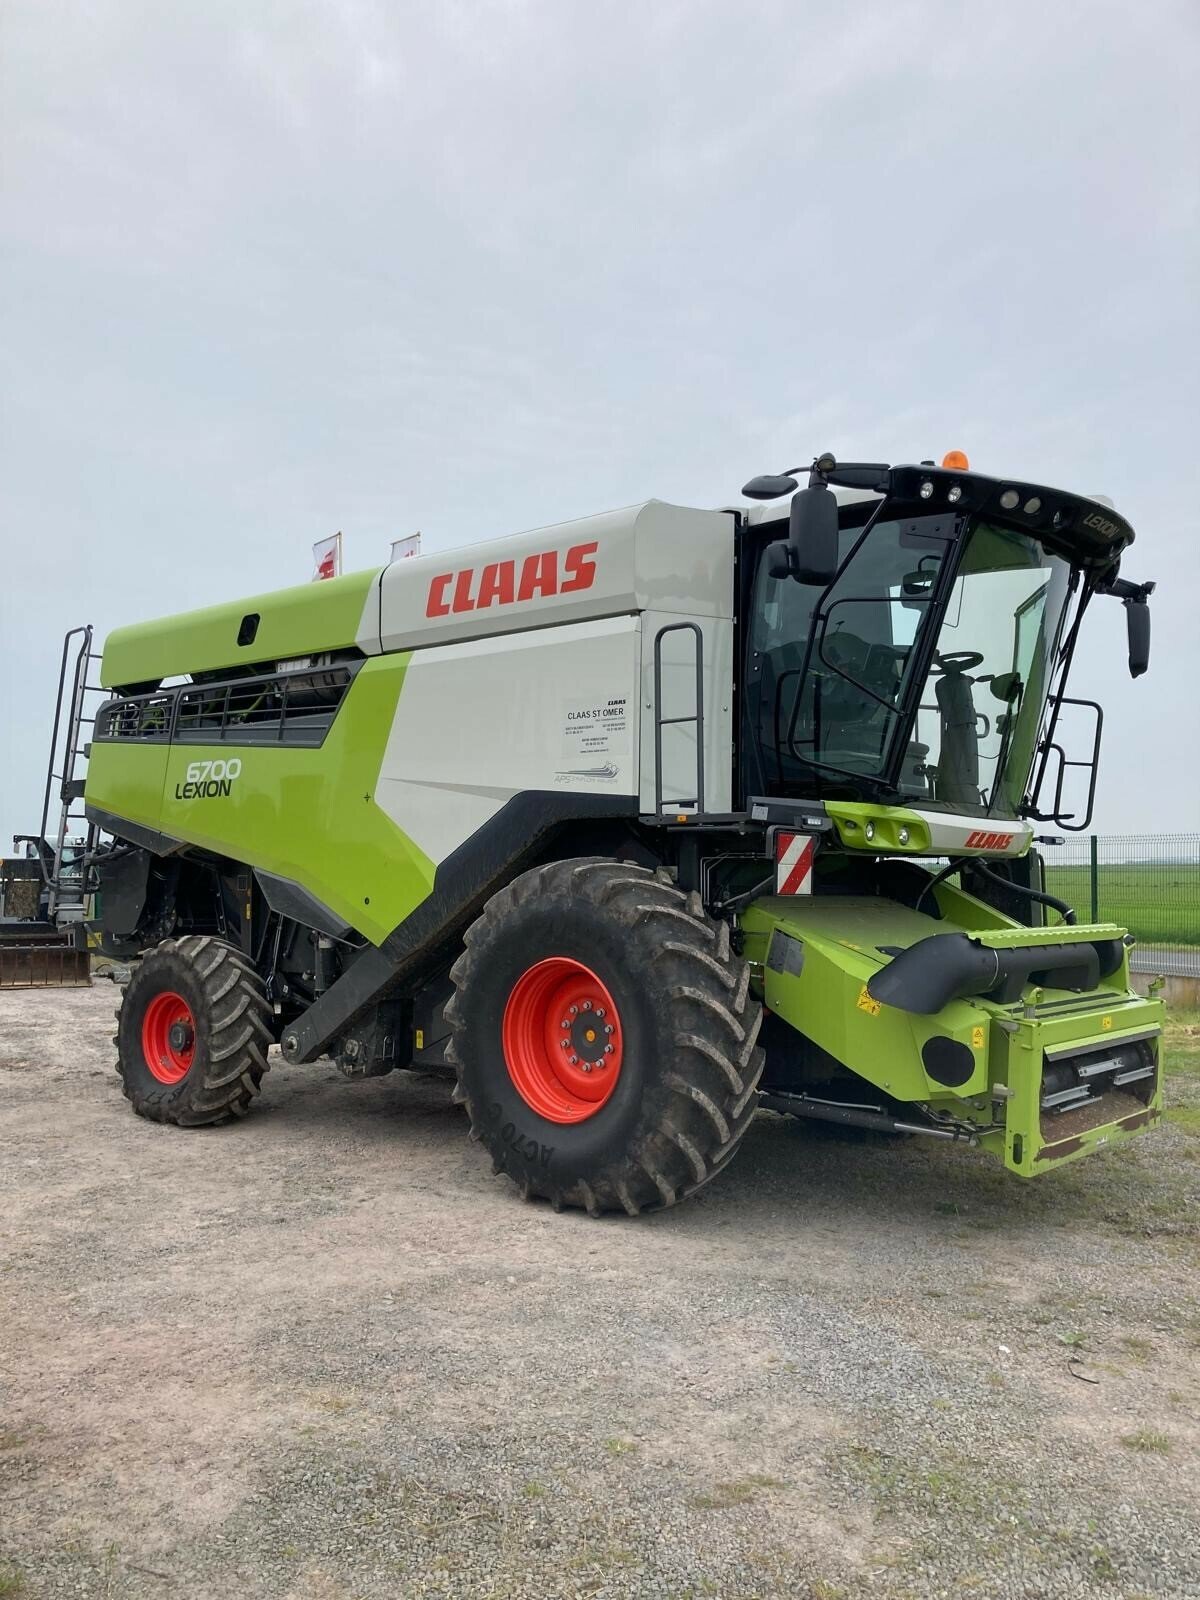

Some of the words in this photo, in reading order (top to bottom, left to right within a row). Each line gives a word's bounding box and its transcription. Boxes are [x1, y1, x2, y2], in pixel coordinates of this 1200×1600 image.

[1083, 512, 1120, 538] LEXION
[426, 541, 599, 618] CLAAS
[567, 710, 591, 720] CLAAS
[592, 709, 601, 718] ST
[602, 707, 624, 717] OMER
[186, 758, 242, 783] 6700
[175, 778, 232, 800] LEXION
[964, 831, 1015, 850] CLAAS
